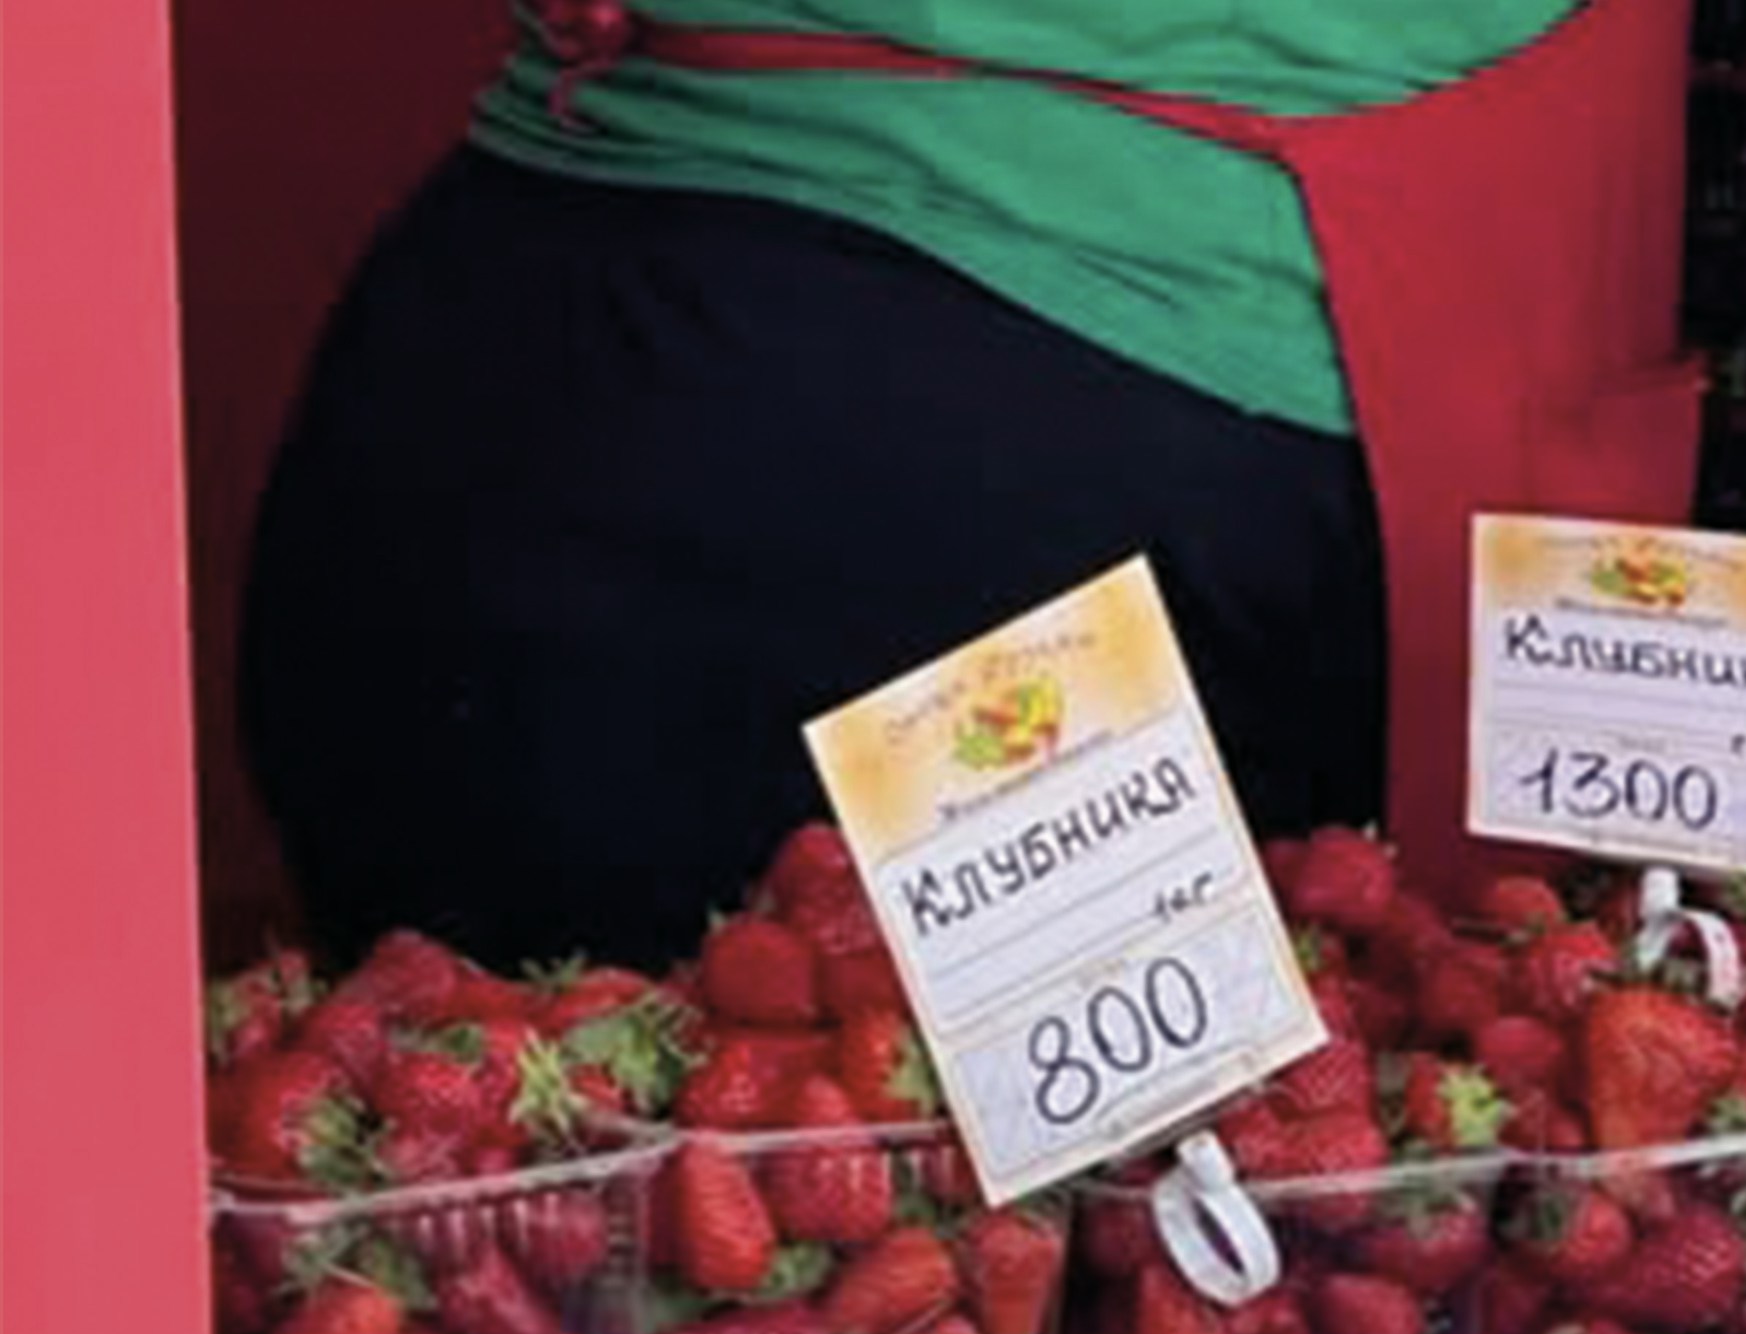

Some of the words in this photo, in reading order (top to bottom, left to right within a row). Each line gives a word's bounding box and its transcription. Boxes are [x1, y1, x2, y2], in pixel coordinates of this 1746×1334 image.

[900, 755, 1197, 938] КЛУБНИКА
[1519, 747, 1718, 830] 1300
[1028, 956, 1209, 1126] 800
